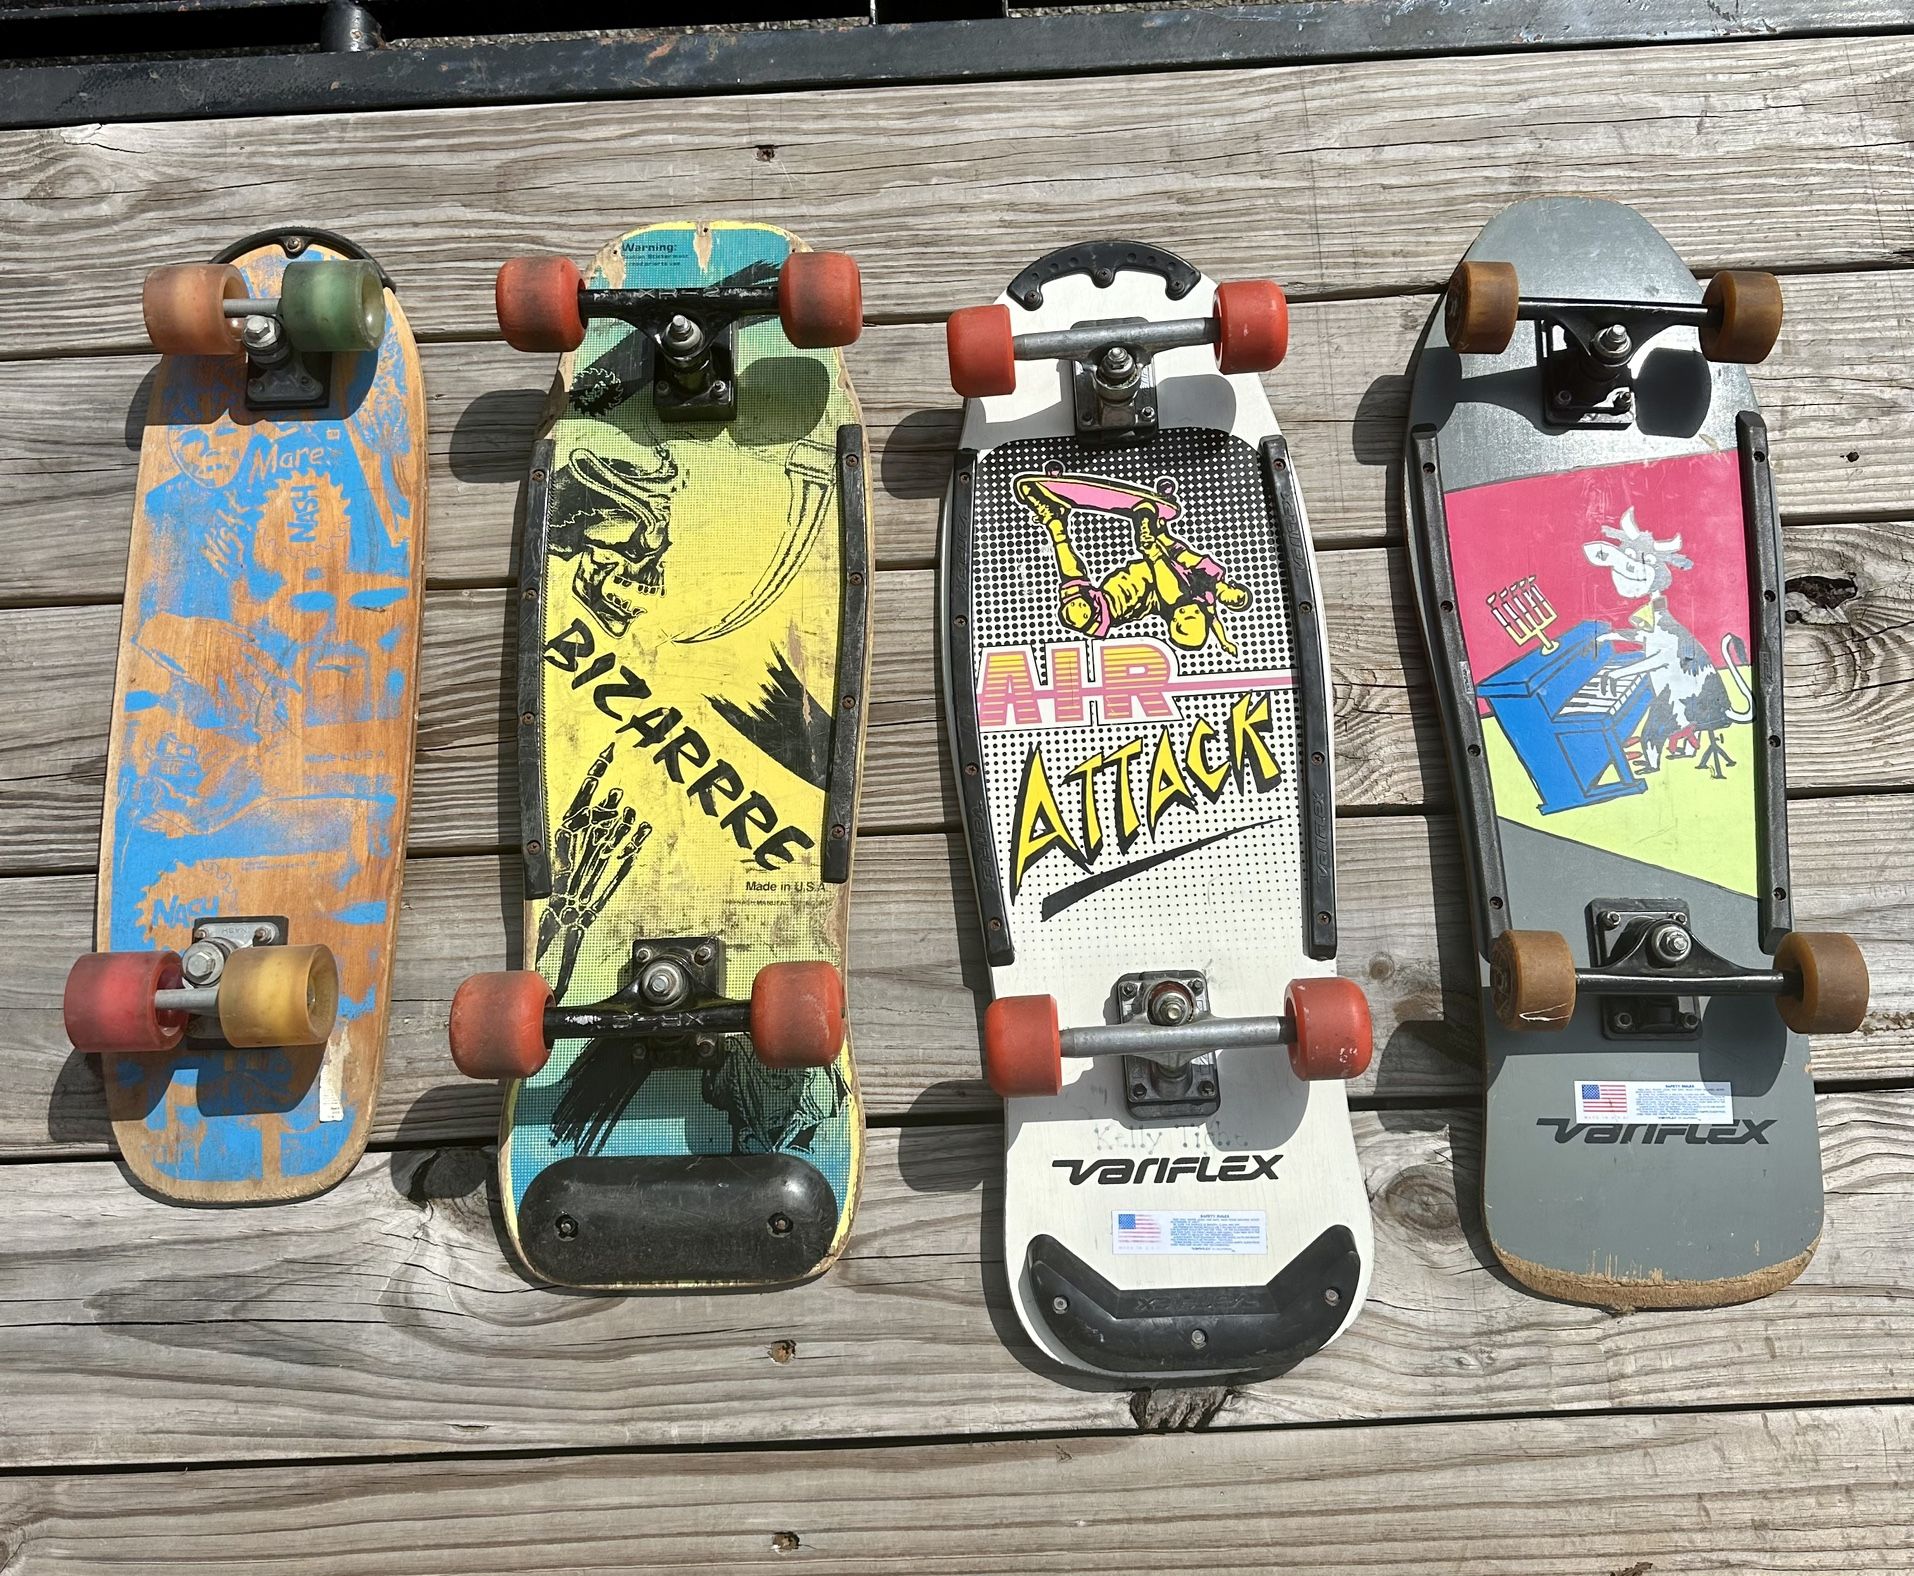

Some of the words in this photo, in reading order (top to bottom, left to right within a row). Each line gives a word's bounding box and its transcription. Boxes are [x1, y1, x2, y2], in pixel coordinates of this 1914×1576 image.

[622, 242, 678, 253] Warning:
[289, 484, 320, 544] NASH
[979, 643, 1174, 727] AIR
[544, 617, 816, 872] BIZARRRE
[1010, 690, 1284, 907] ATTACK
[152, 897, 220, 930] NASH
[745, 881, 778, 892] Made
[780, 882, 791, 892] in
